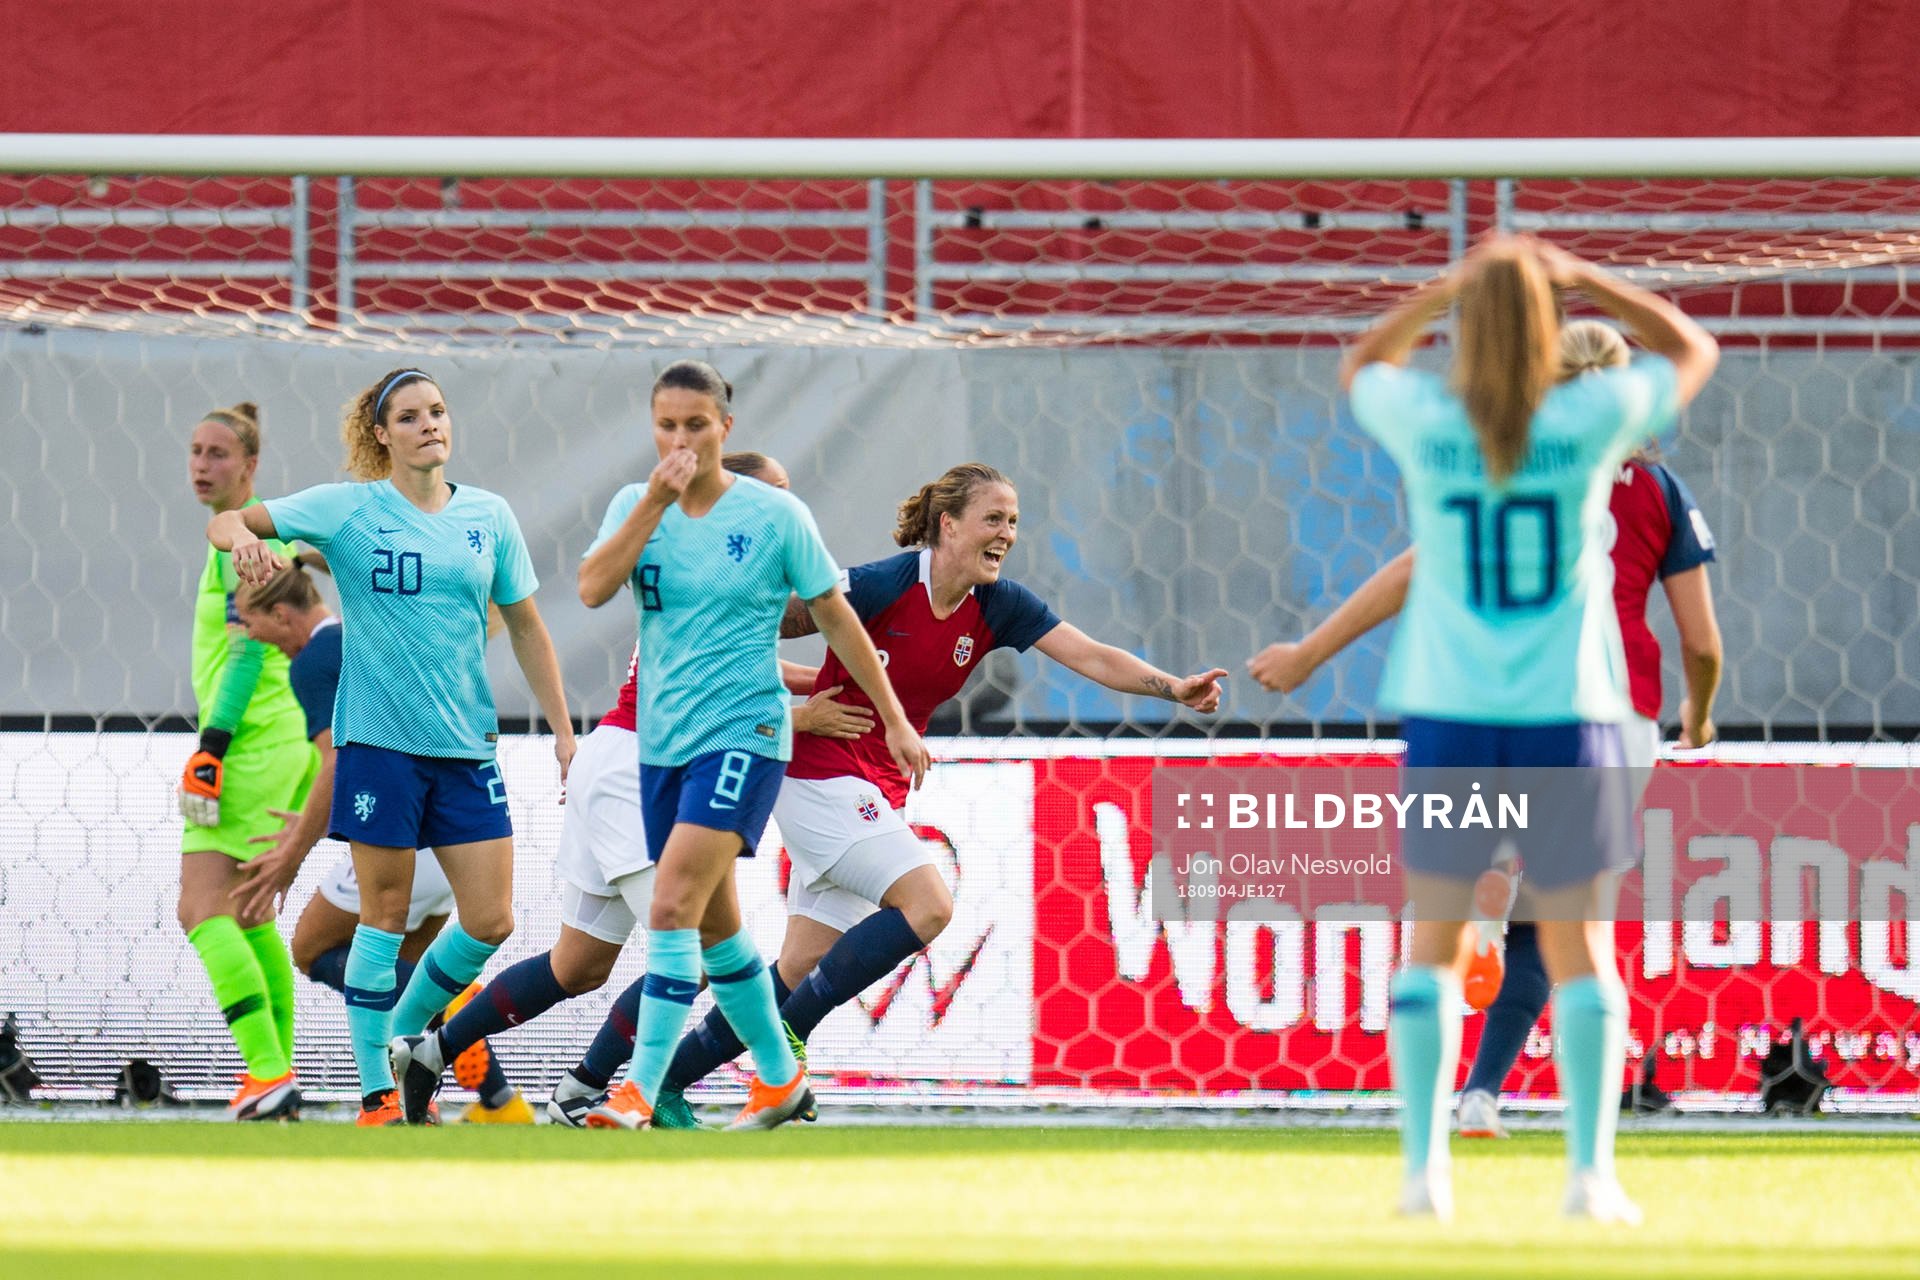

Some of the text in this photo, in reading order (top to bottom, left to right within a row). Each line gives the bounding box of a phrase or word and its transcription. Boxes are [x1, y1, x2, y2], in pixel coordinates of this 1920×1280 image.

[371, 549, 422, 595] 20
[1443, 493, 1557, 609] 10
[640, 563, 662, 612] 8
[714, 750, 751, 802] 8
[1664, 1020, 1714, 1060] of
